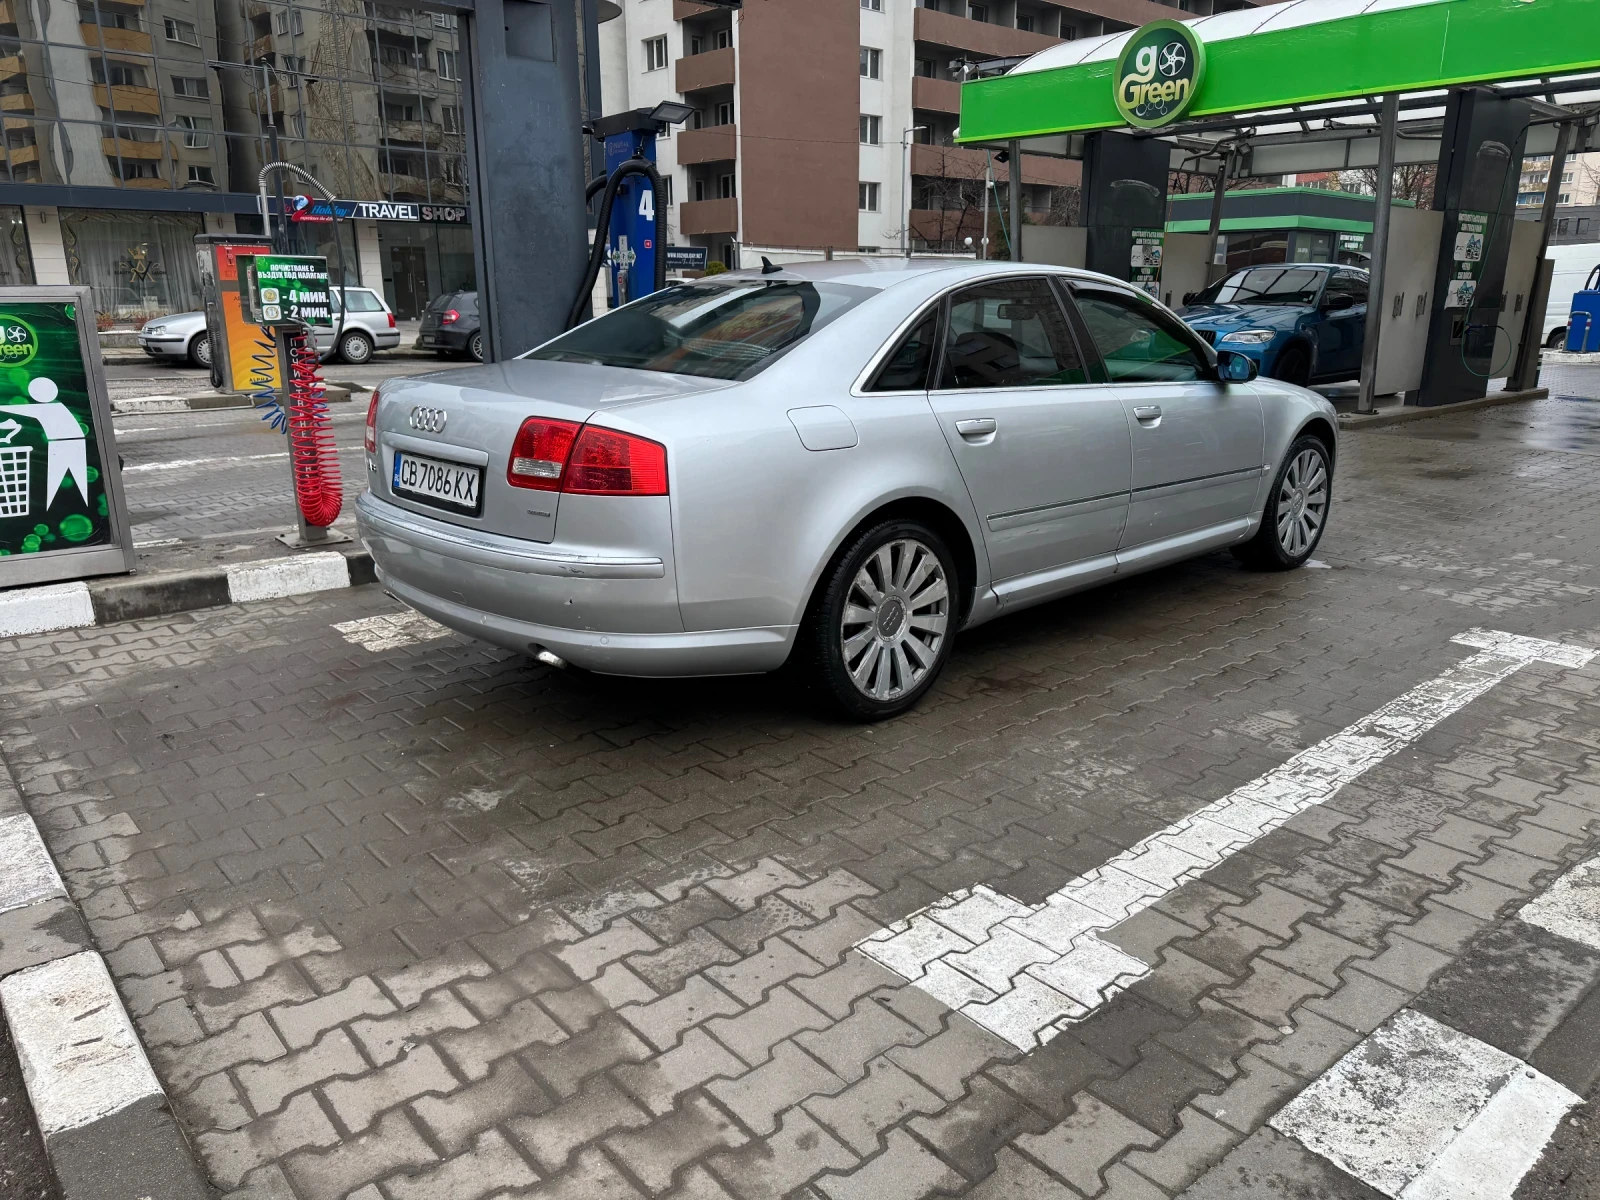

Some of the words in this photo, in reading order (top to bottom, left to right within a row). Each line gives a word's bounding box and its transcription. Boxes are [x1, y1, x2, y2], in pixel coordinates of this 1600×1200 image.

[1119, 74, 1189, 109] Green
[359, 203, 418, 220] TRAVEL
[422, 206, 466, 221] SHOP
[638, 189, 655, 221] 4
[270, 264, 309, 272] ПОЧИСТВАНЕ
[289, 289, 298, 303] 4
[299, 291, 329, 303] МИН.
[290, 305, 299, 318] 2
[300, 307, 331, 318] МИН.
